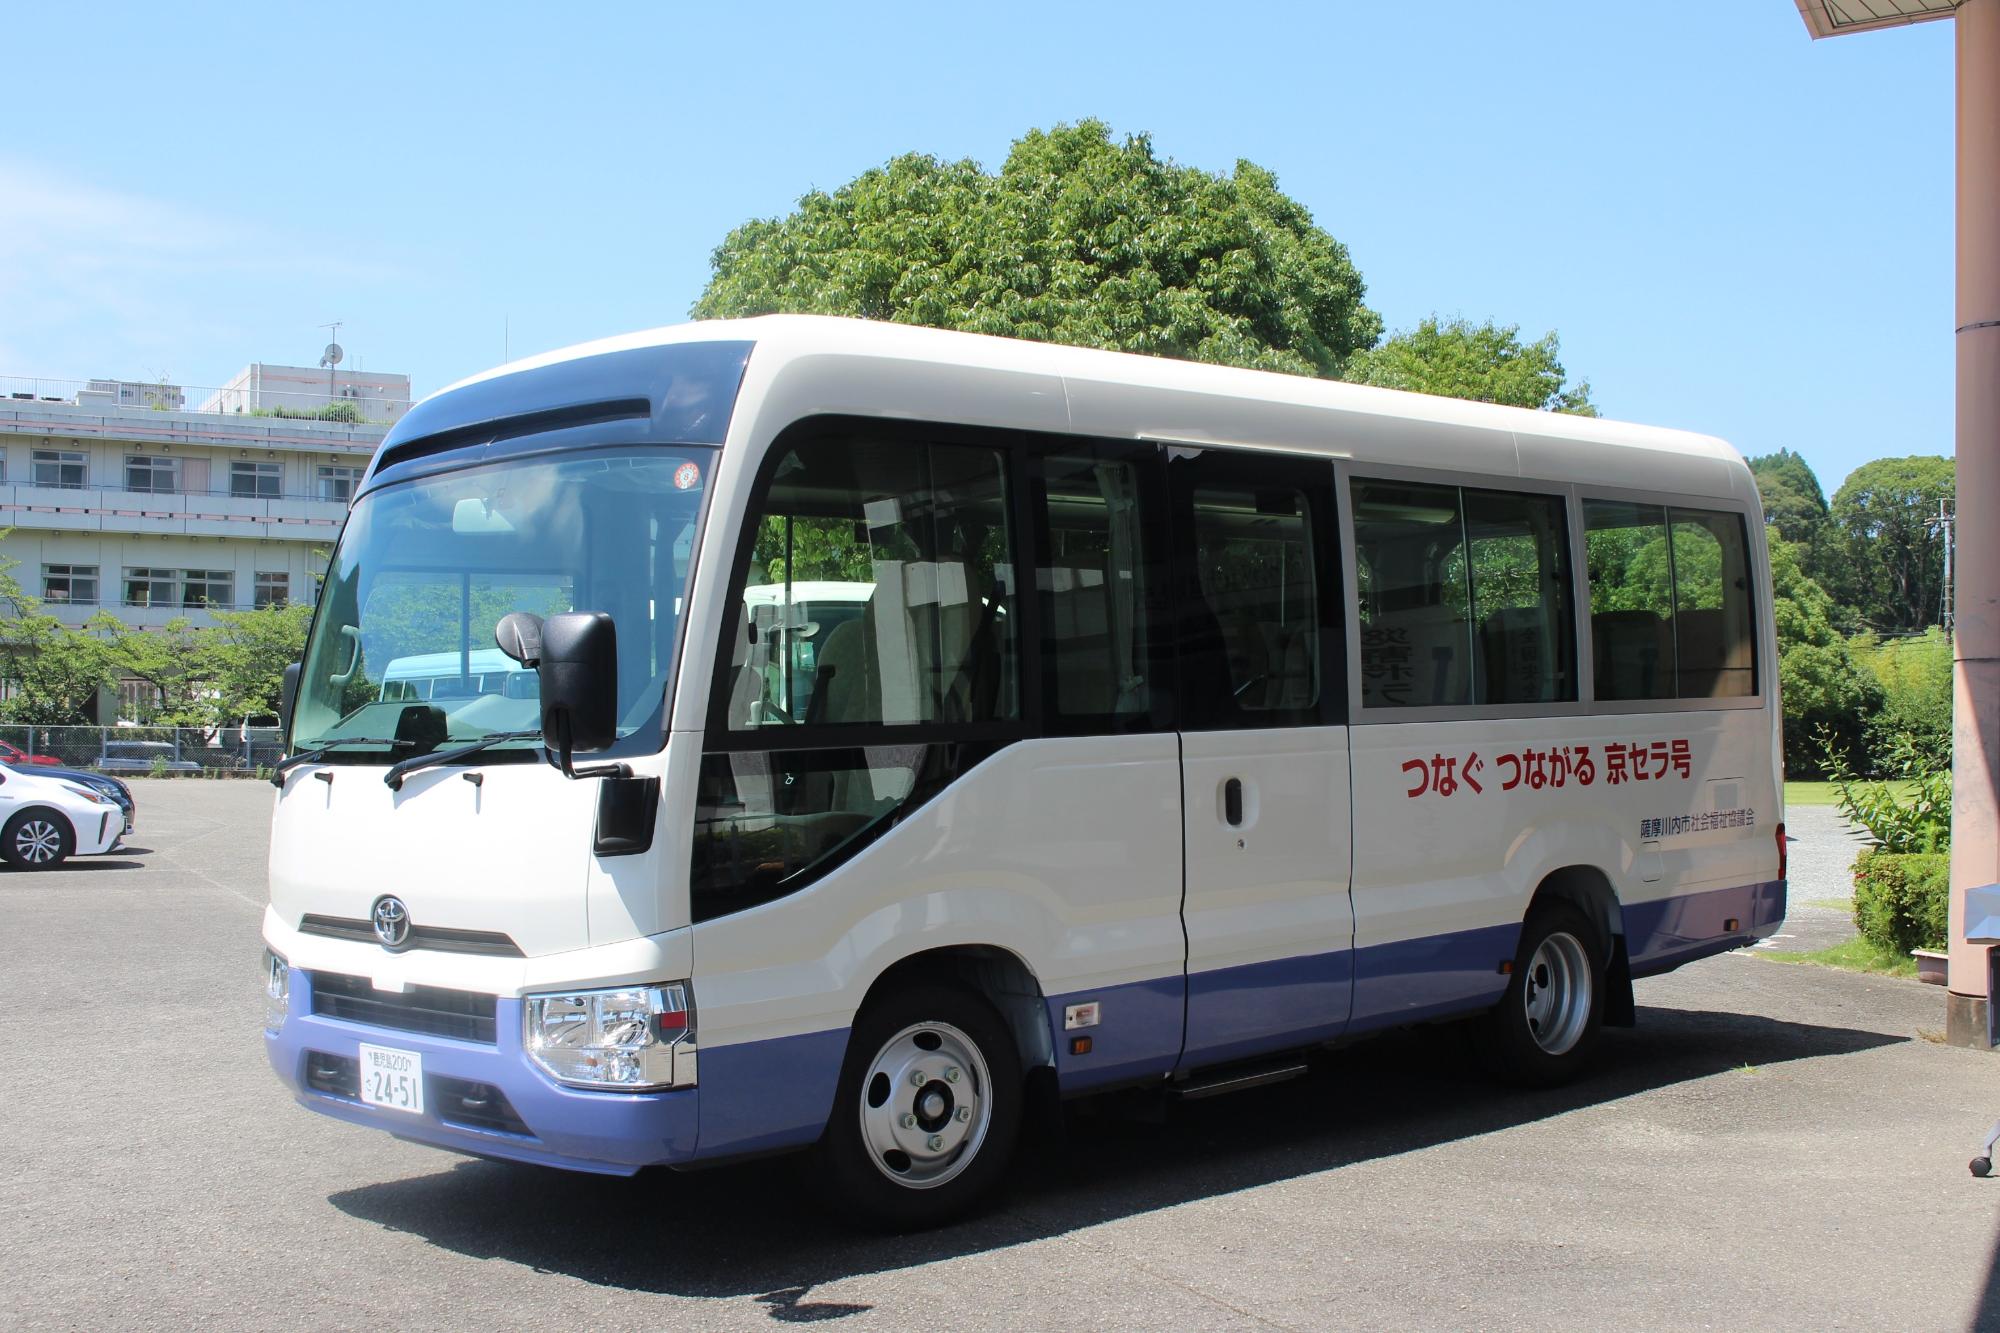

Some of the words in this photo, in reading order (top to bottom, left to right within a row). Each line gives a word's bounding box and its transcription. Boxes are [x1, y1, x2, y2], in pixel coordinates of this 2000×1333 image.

[1402, 751, 1484, 798] つなぐ
[1496, 745, 1596, 791] つながる
[1604, 739, 1692, 785] 京セラ号
[1640, 808, 1754, 838] 薩摩川内市社会福祉協議会
[374, 1071, 418, 1108] 24-51
